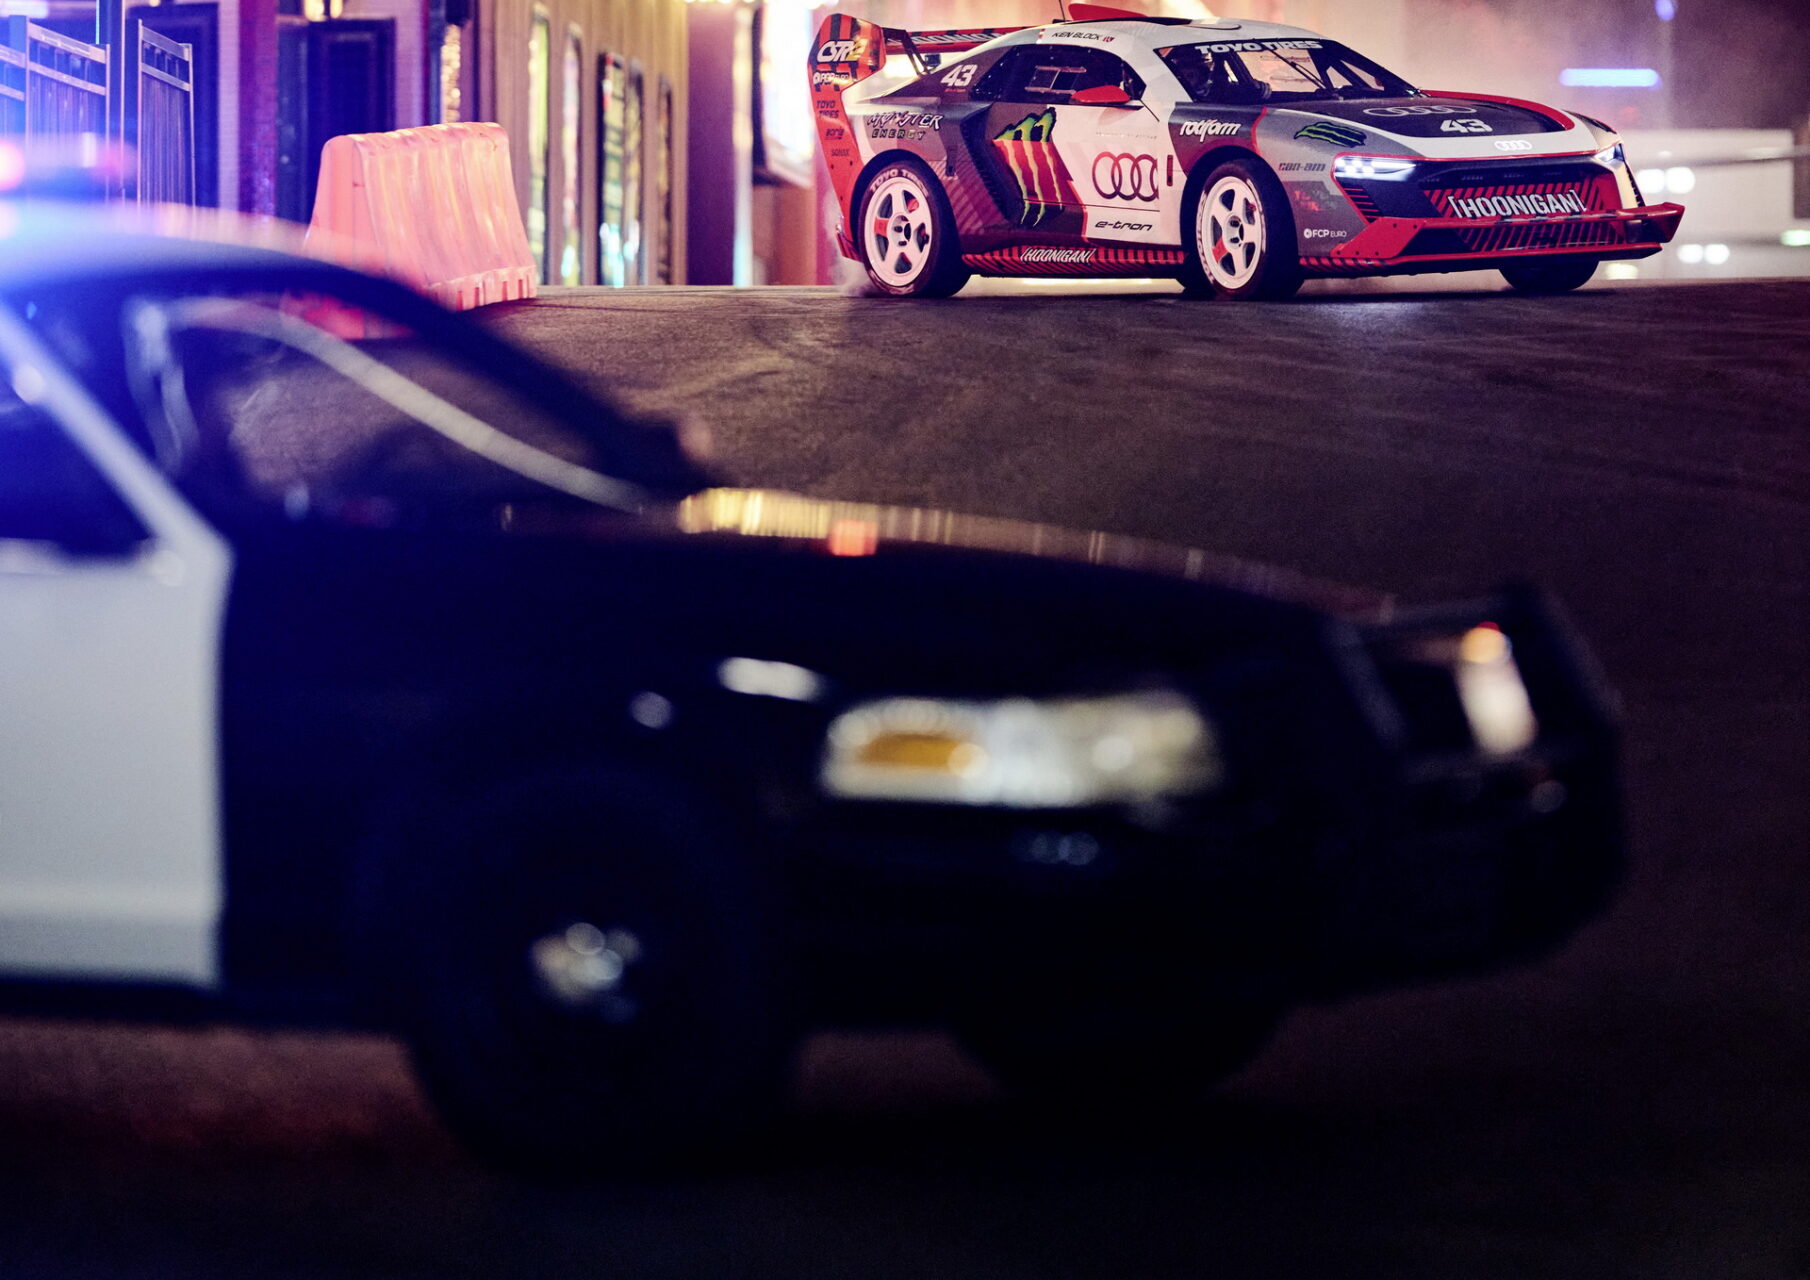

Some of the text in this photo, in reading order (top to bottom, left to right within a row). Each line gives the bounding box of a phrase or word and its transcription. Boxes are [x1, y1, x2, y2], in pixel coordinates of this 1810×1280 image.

[1194, 40, 1323, 54] TOYO TIRES
[941, 64, 978, 87] 43
[1440, 119, 1493, 133] 43
[872, 128, 926, 140] ENERGY
[1278, 163, 1326, 171] can-am
[870, 169, 899, 193] TOYO
[1095, 220, 1153, 231] e-tron
[1312, 228, 1330, 238] FCP
